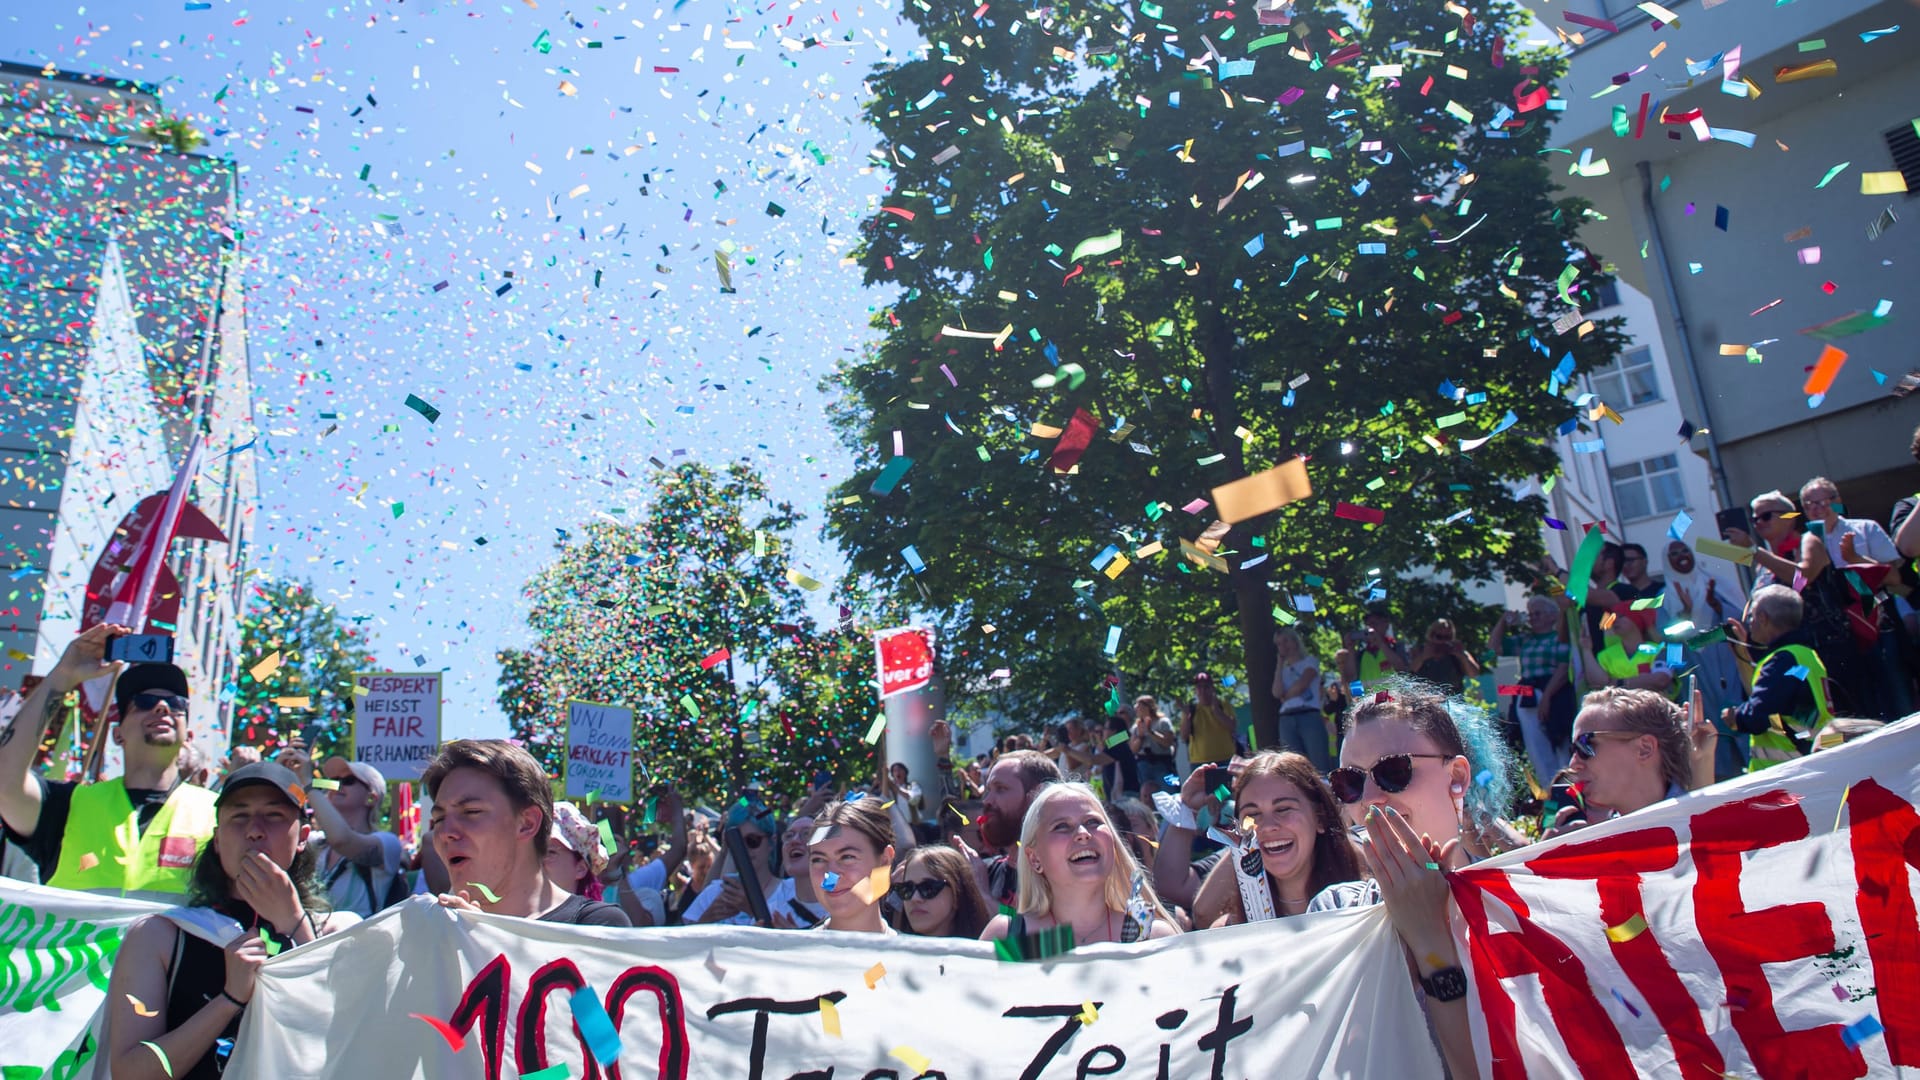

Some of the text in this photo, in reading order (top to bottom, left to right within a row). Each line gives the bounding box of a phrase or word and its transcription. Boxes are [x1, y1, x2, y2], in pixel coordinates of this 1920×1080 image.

[359, 676, 438, 695] RESPEKT
[365, 699, 421, 713] HEISST
[373, 716, 424, 738] FAIR
[571, 706, 604, 729] UNI
[588, 728, 630, 749] BONN
